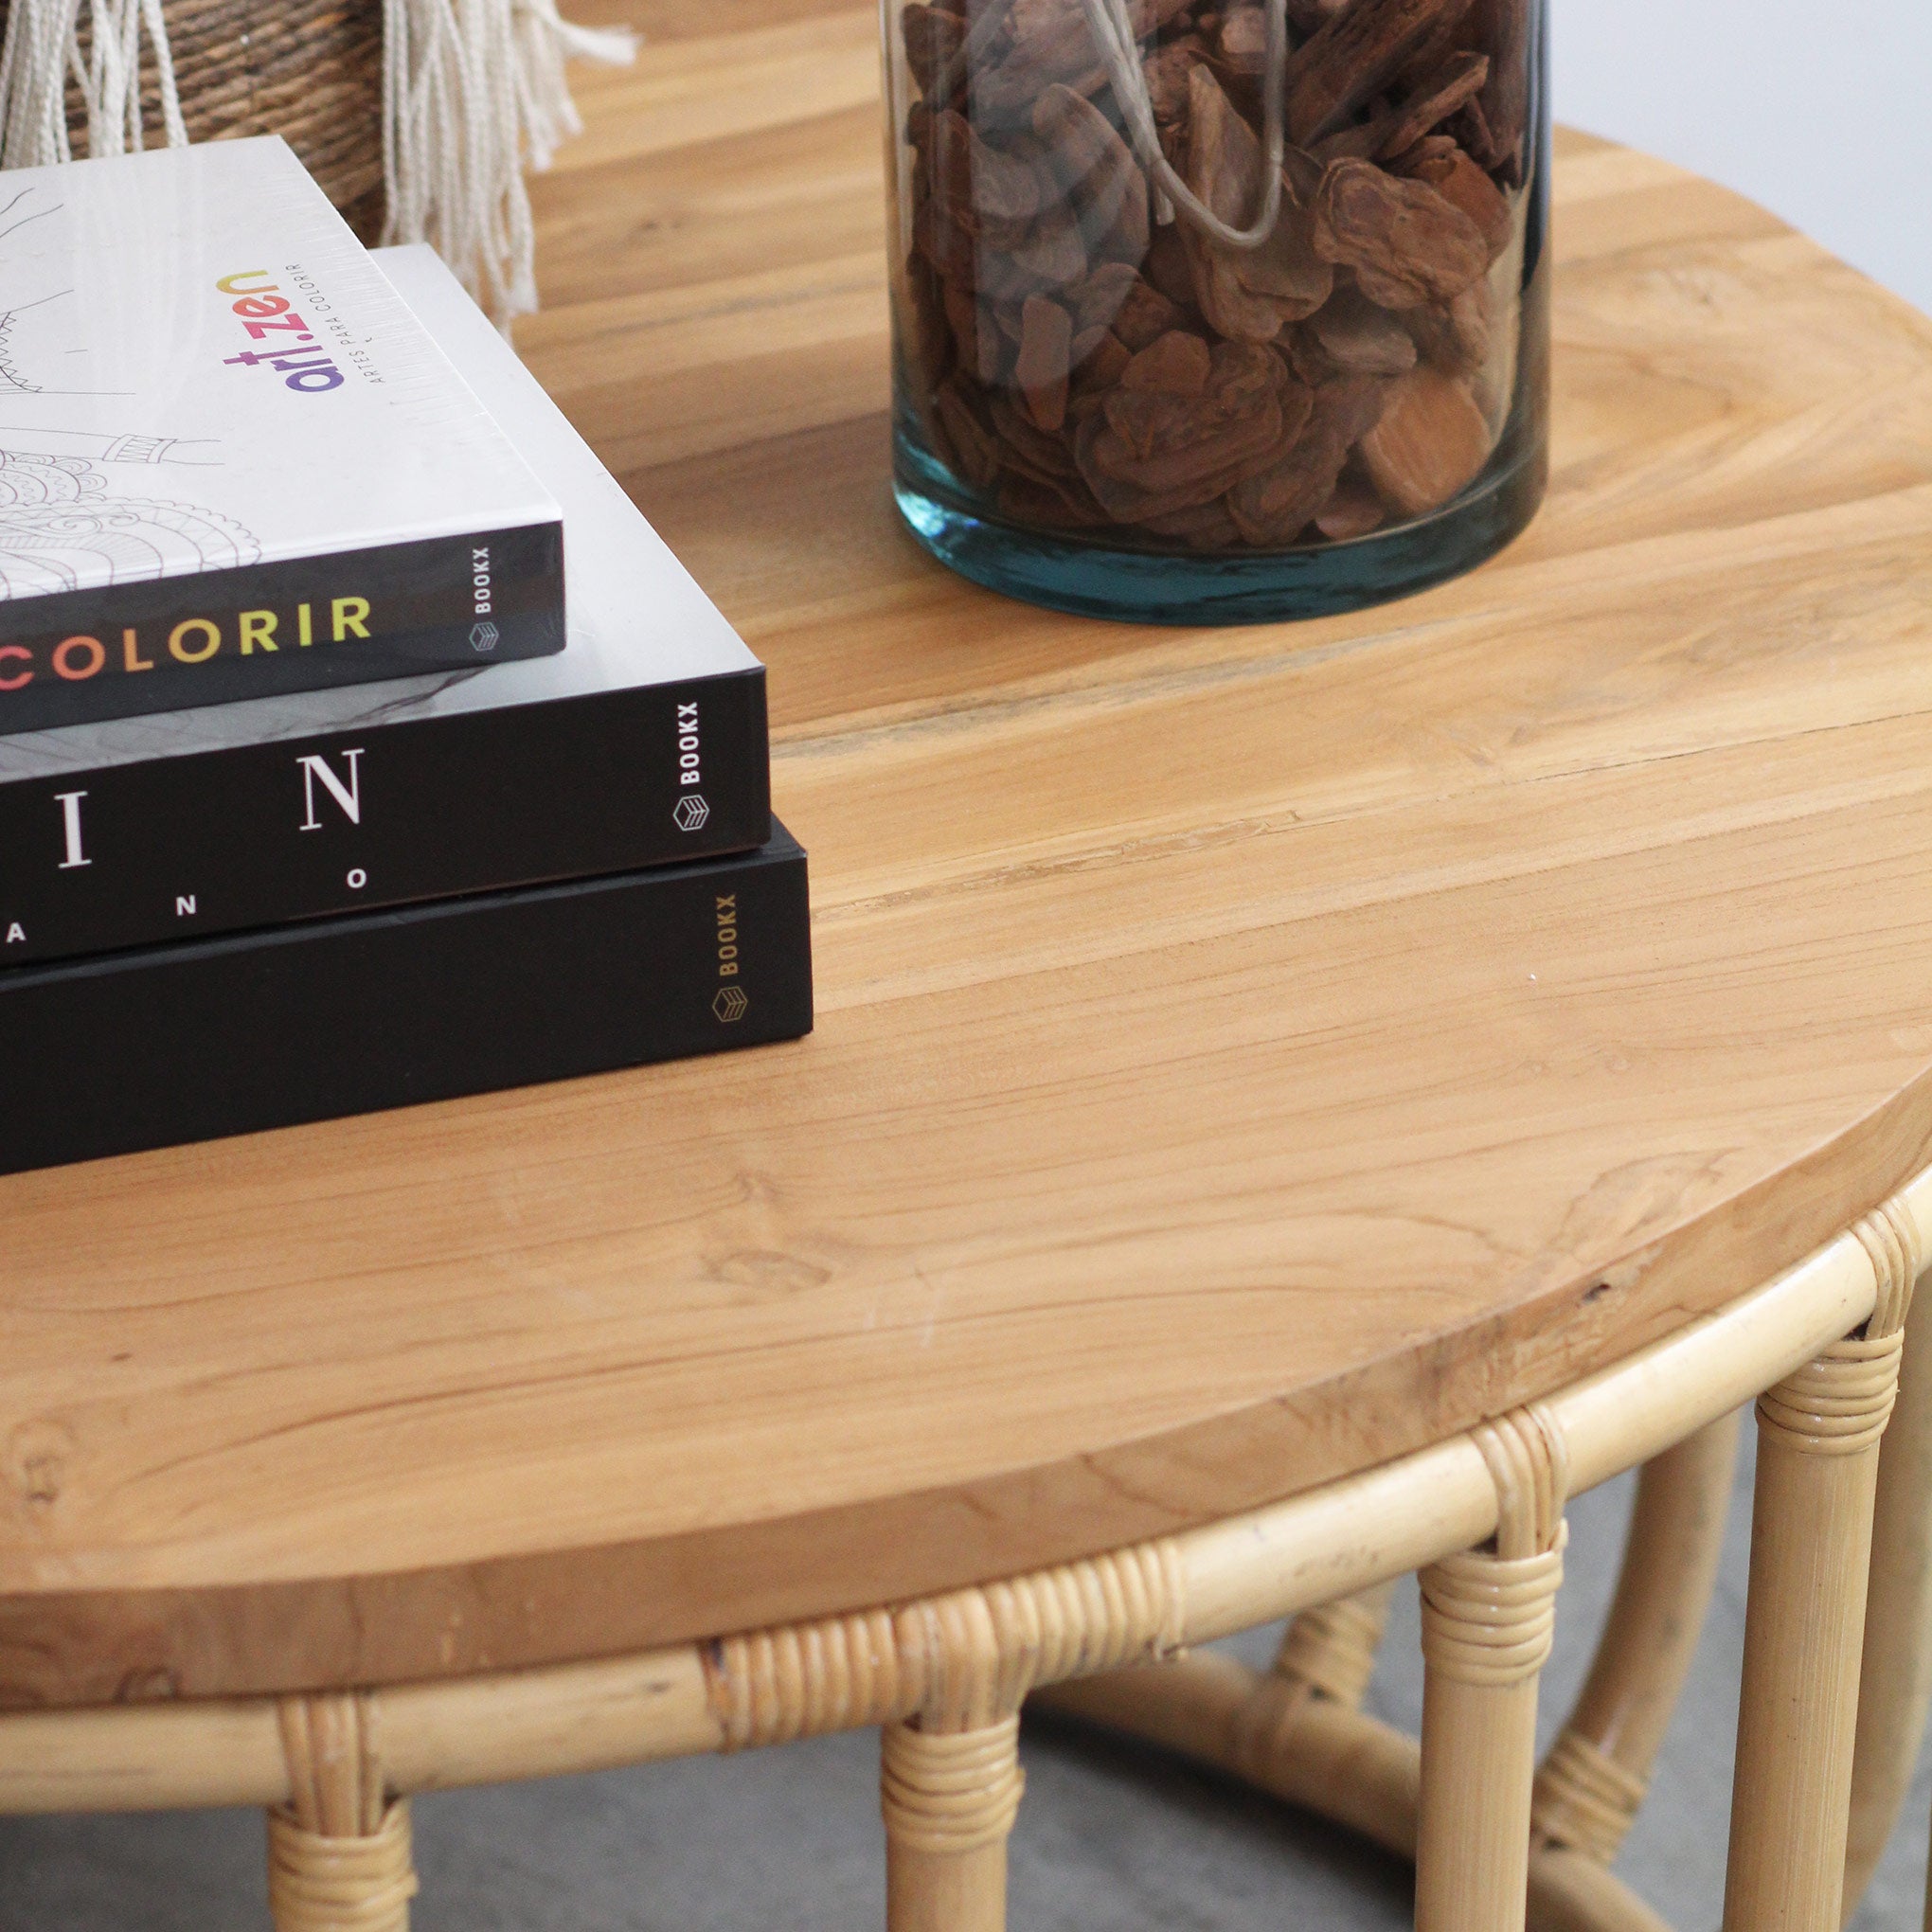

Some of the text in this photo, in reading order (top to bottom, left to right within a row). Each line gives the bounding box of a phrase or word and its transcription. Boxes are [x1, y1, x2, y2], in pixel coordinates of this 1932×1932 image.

[215, 269, 345, 392] art.zen
[285, 263, 386, 384] ARTES PARA COLORIR
[473, 547, 492, 614] BOOKX
[0, 596, 372, 691] COLORIR
[677, 702, 701, 785] BOOKX
[716, 894, 739, 976] BOOKX
